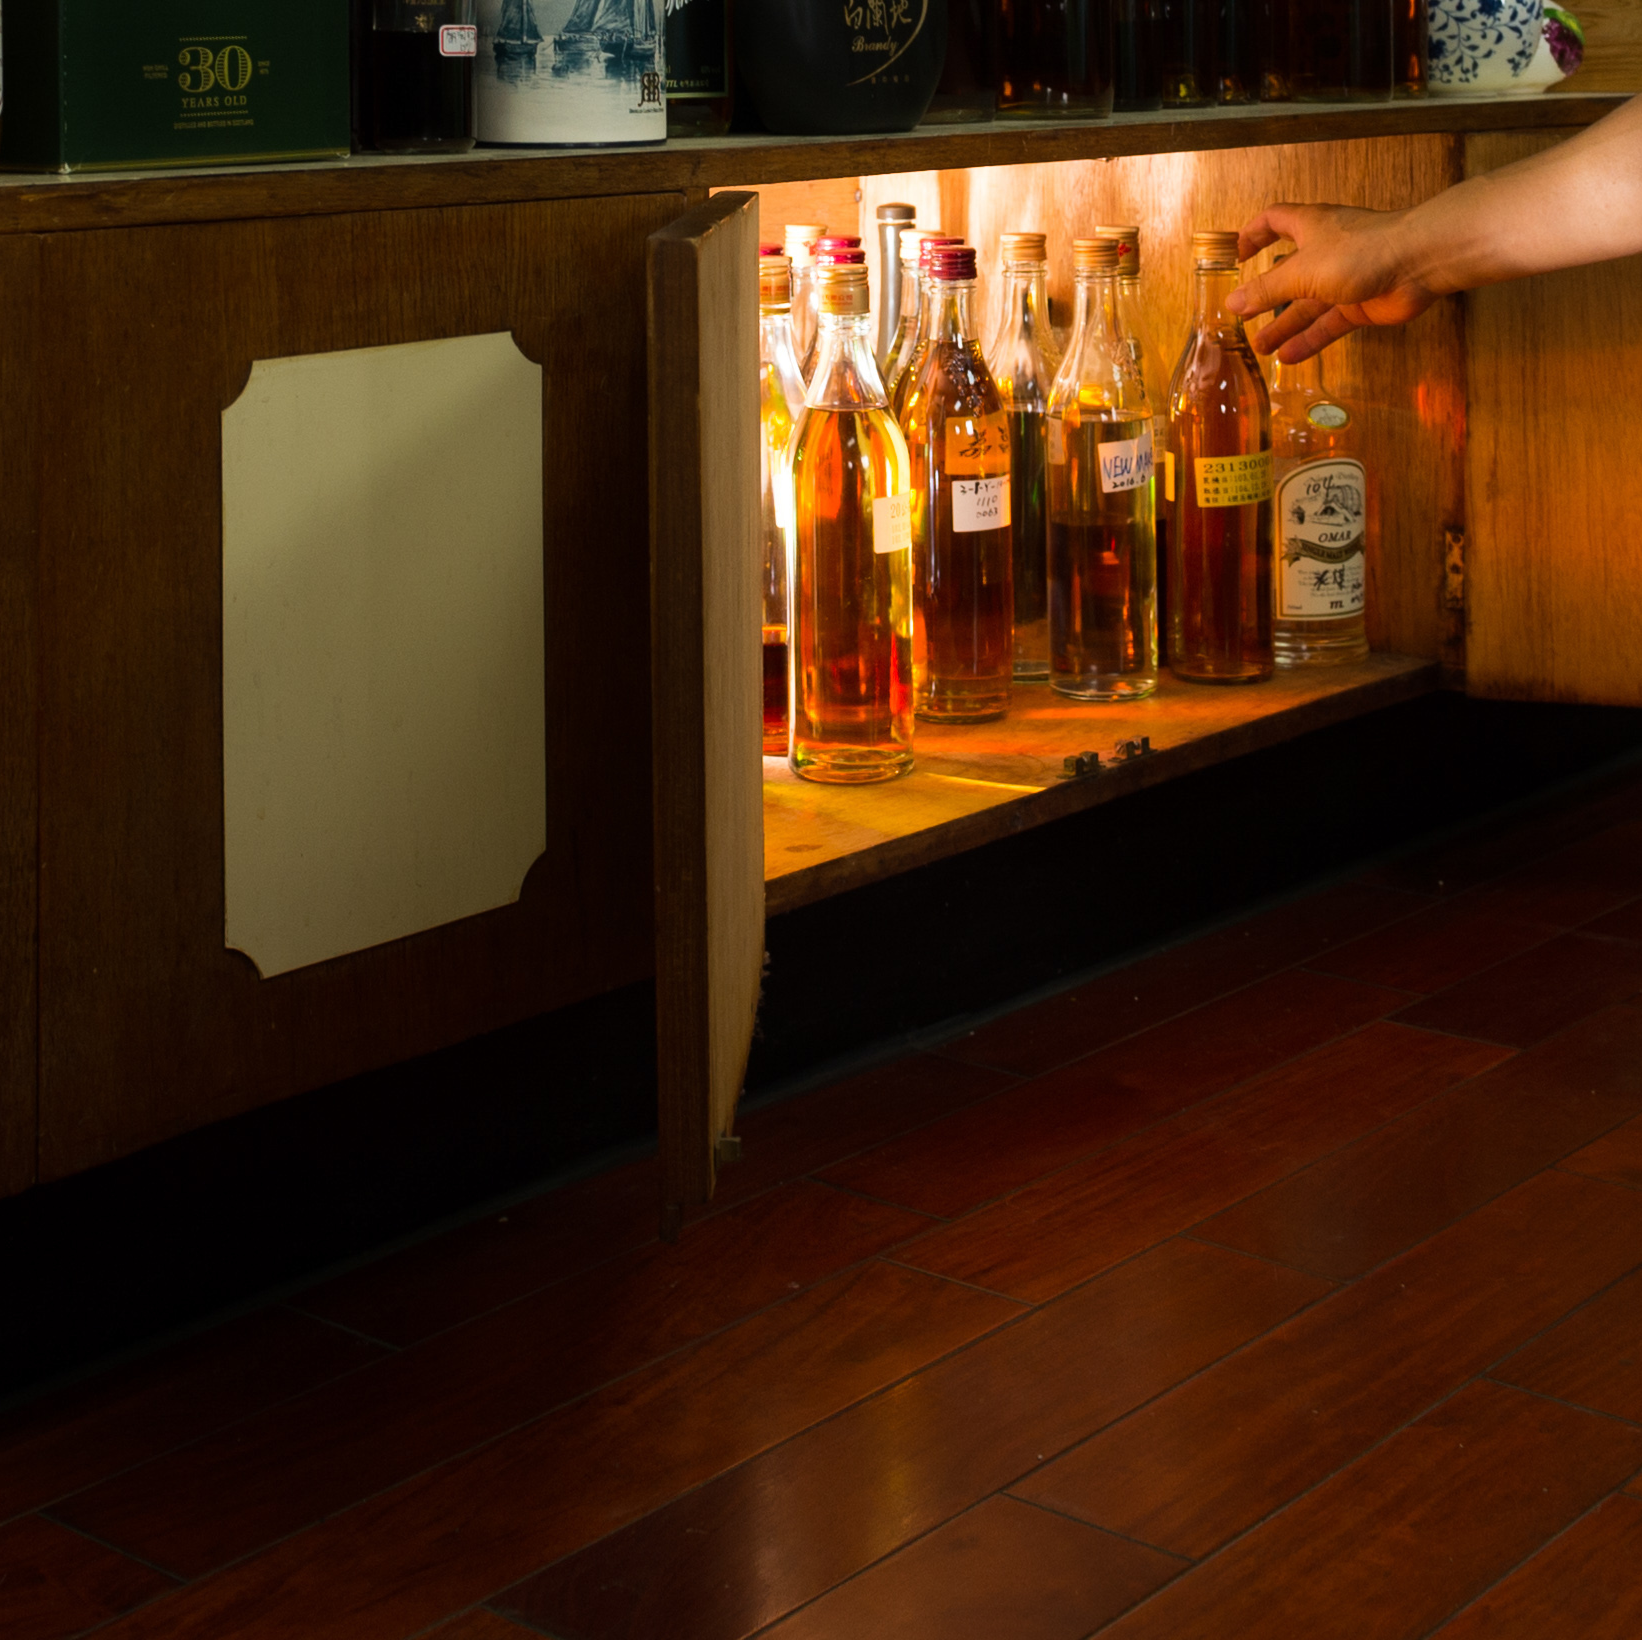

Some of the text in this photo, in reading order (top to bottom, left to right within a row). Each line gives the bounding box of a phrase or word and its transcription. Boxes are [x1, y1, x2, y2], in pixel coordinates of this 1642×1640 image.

[851, 34, 899, 57] Brandy
[178, 44, 253, 93] 30
[181, 95, 248, 109] YEARS OLD
[1318, 530, 1352, 544] OMAR
